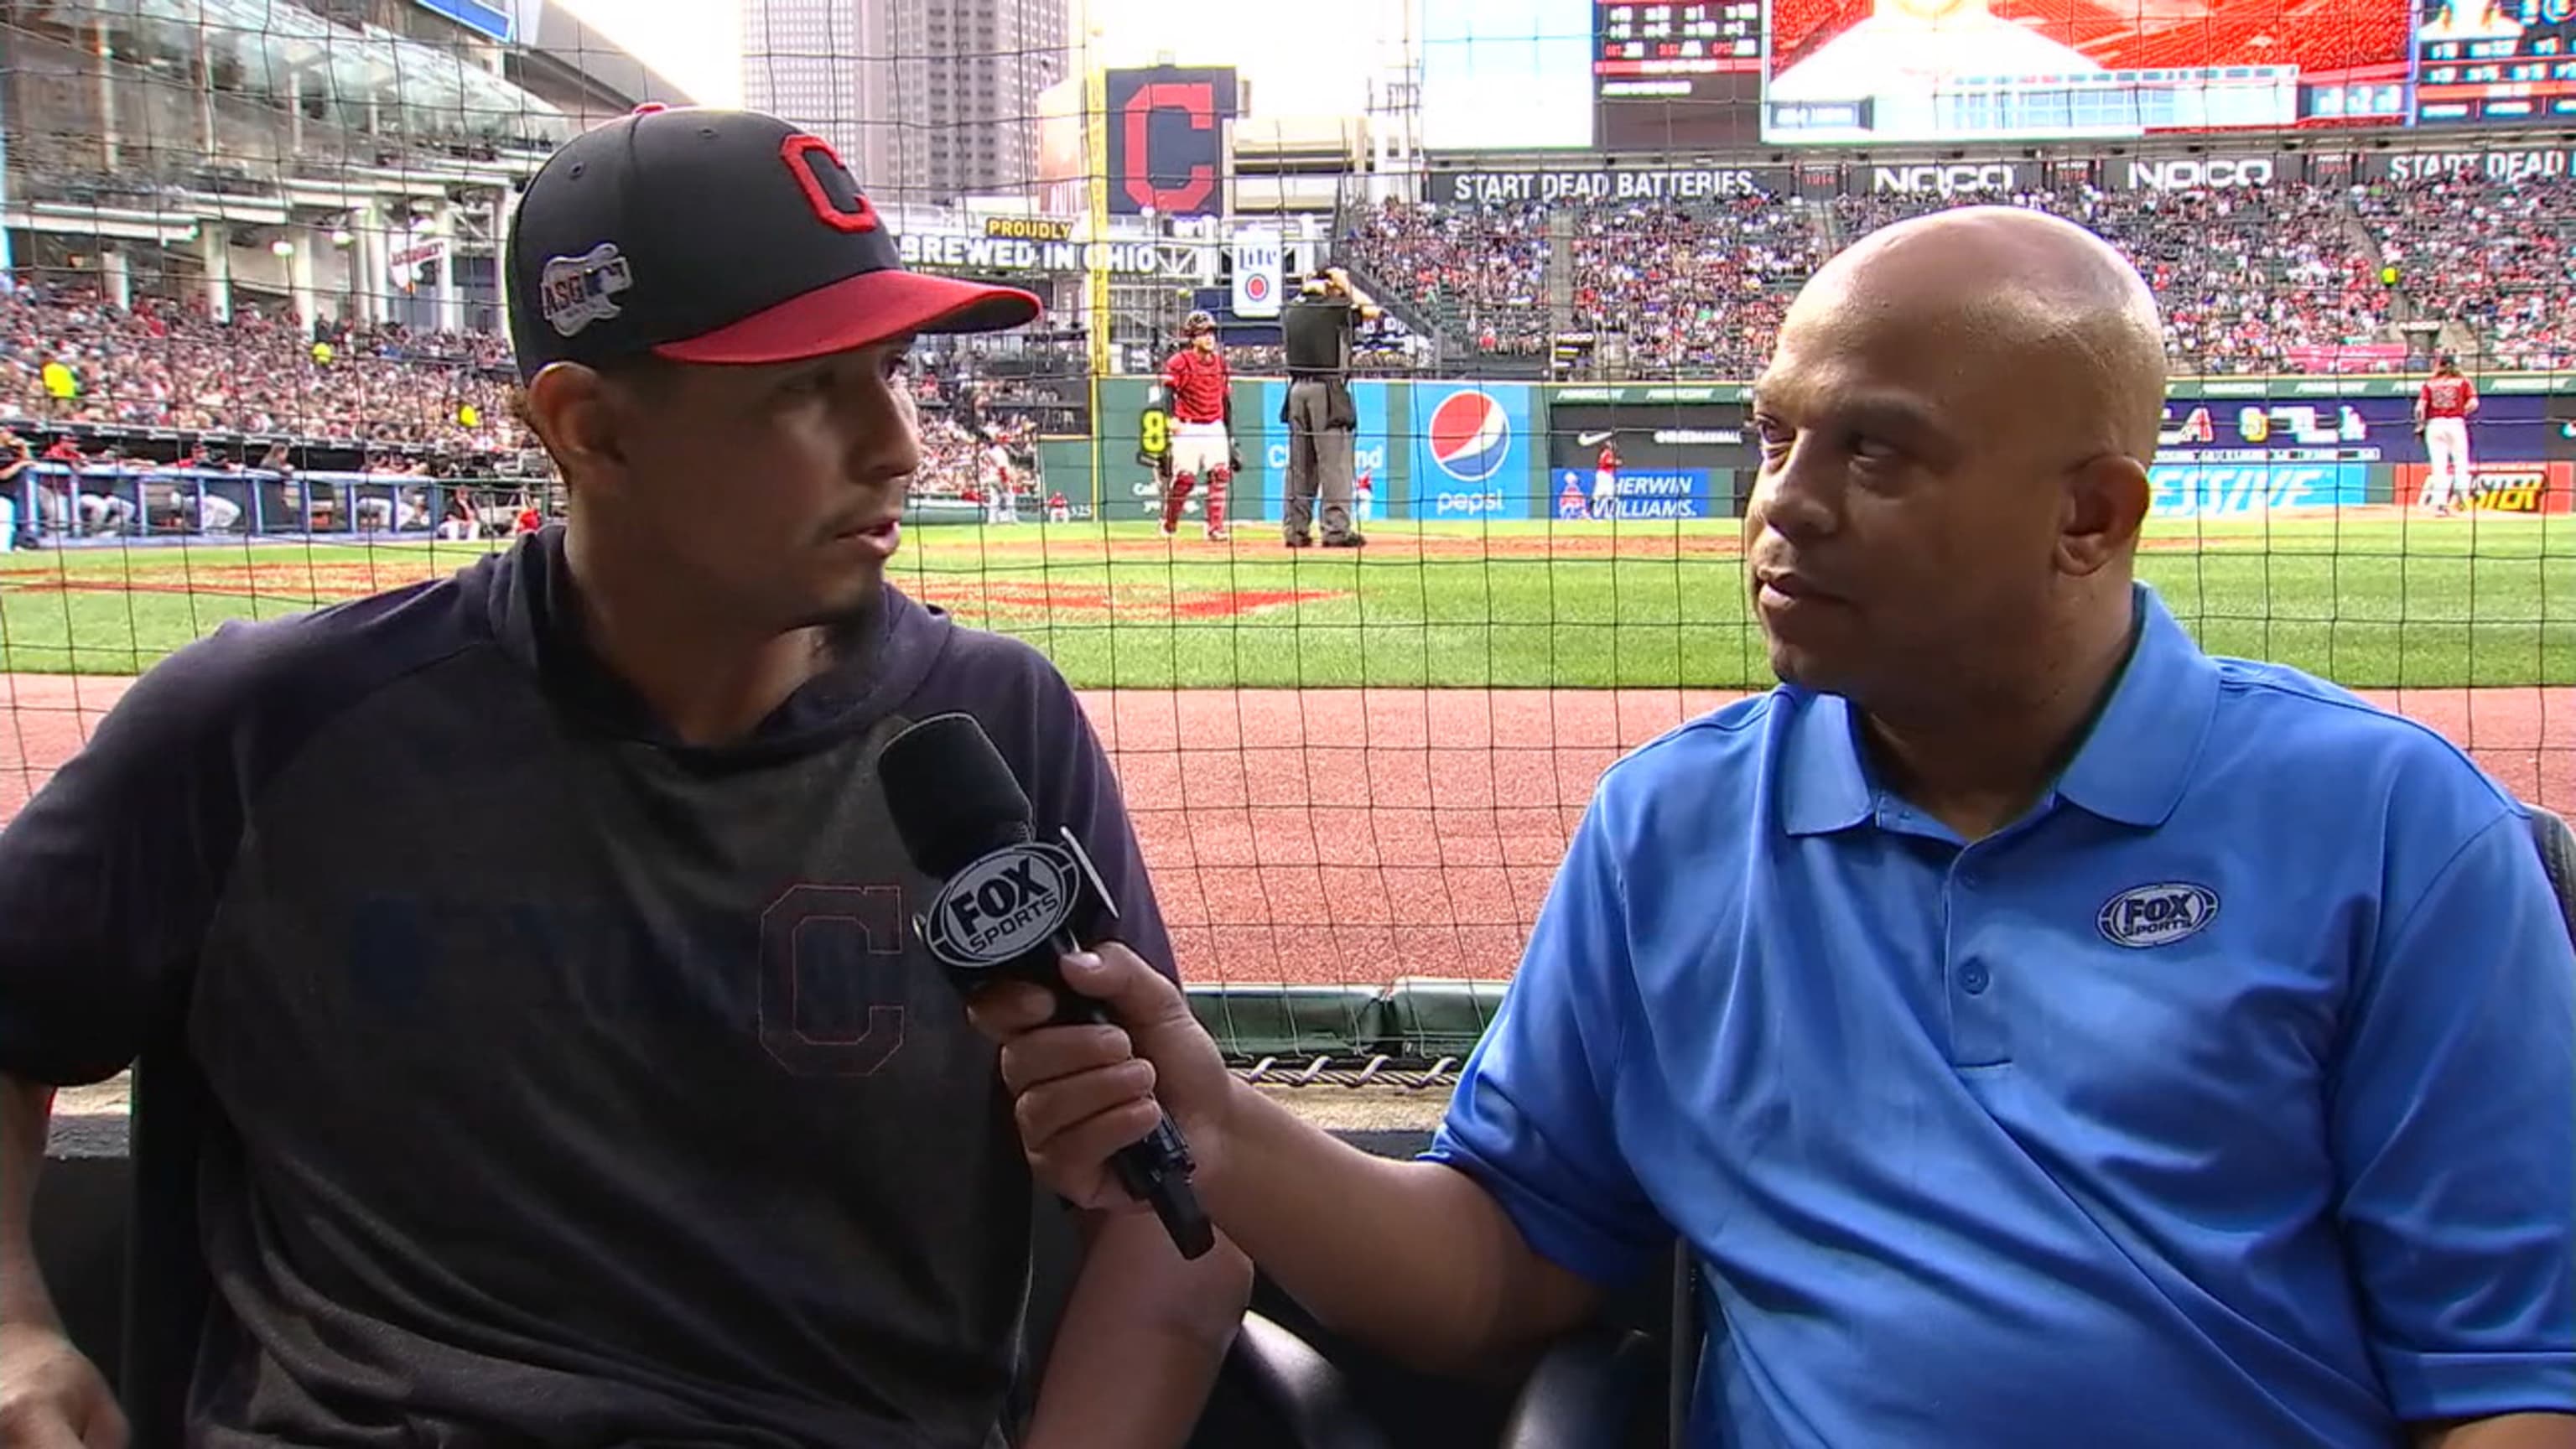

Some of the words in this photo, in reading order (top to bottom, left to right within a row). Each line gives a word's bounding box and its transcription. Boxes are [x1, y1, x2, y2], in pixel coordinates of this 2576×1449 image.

[1124, 83, 1213, 211] C
[1874, 164, 2013, 195] NOCO
[2128, 159, 2272, 190] NOCO
[2486, 150, 2565, 179] DEAD
[781, 134, 876, 232] C
[1455, 173, 1535, 200] START
[1542, 172, 1609, 200] DEAD
[989, 219, 1072, 239] PROUDLY
[900, 235, 1035, 269] BREWED
[1043, 242, 1074, 270] IN
[1083, 242, 1156, 273] OHIO
[1615, 475, 1693, 495] HERWIN
[2148, 467, 2329, 516] ESSIVE
[1436, 487, 1506, 516] pepsi
[1593, 499, 1697, 518] WILLIAMS.
[949, 856, 1050, 938] FOX
[2126, 891, 2194, 927] FOX
[969, 892, 1059, 954] SPORTS
[2124, 919, 2193, 937] SPORTS
[759, 885, 905, 1078] C
